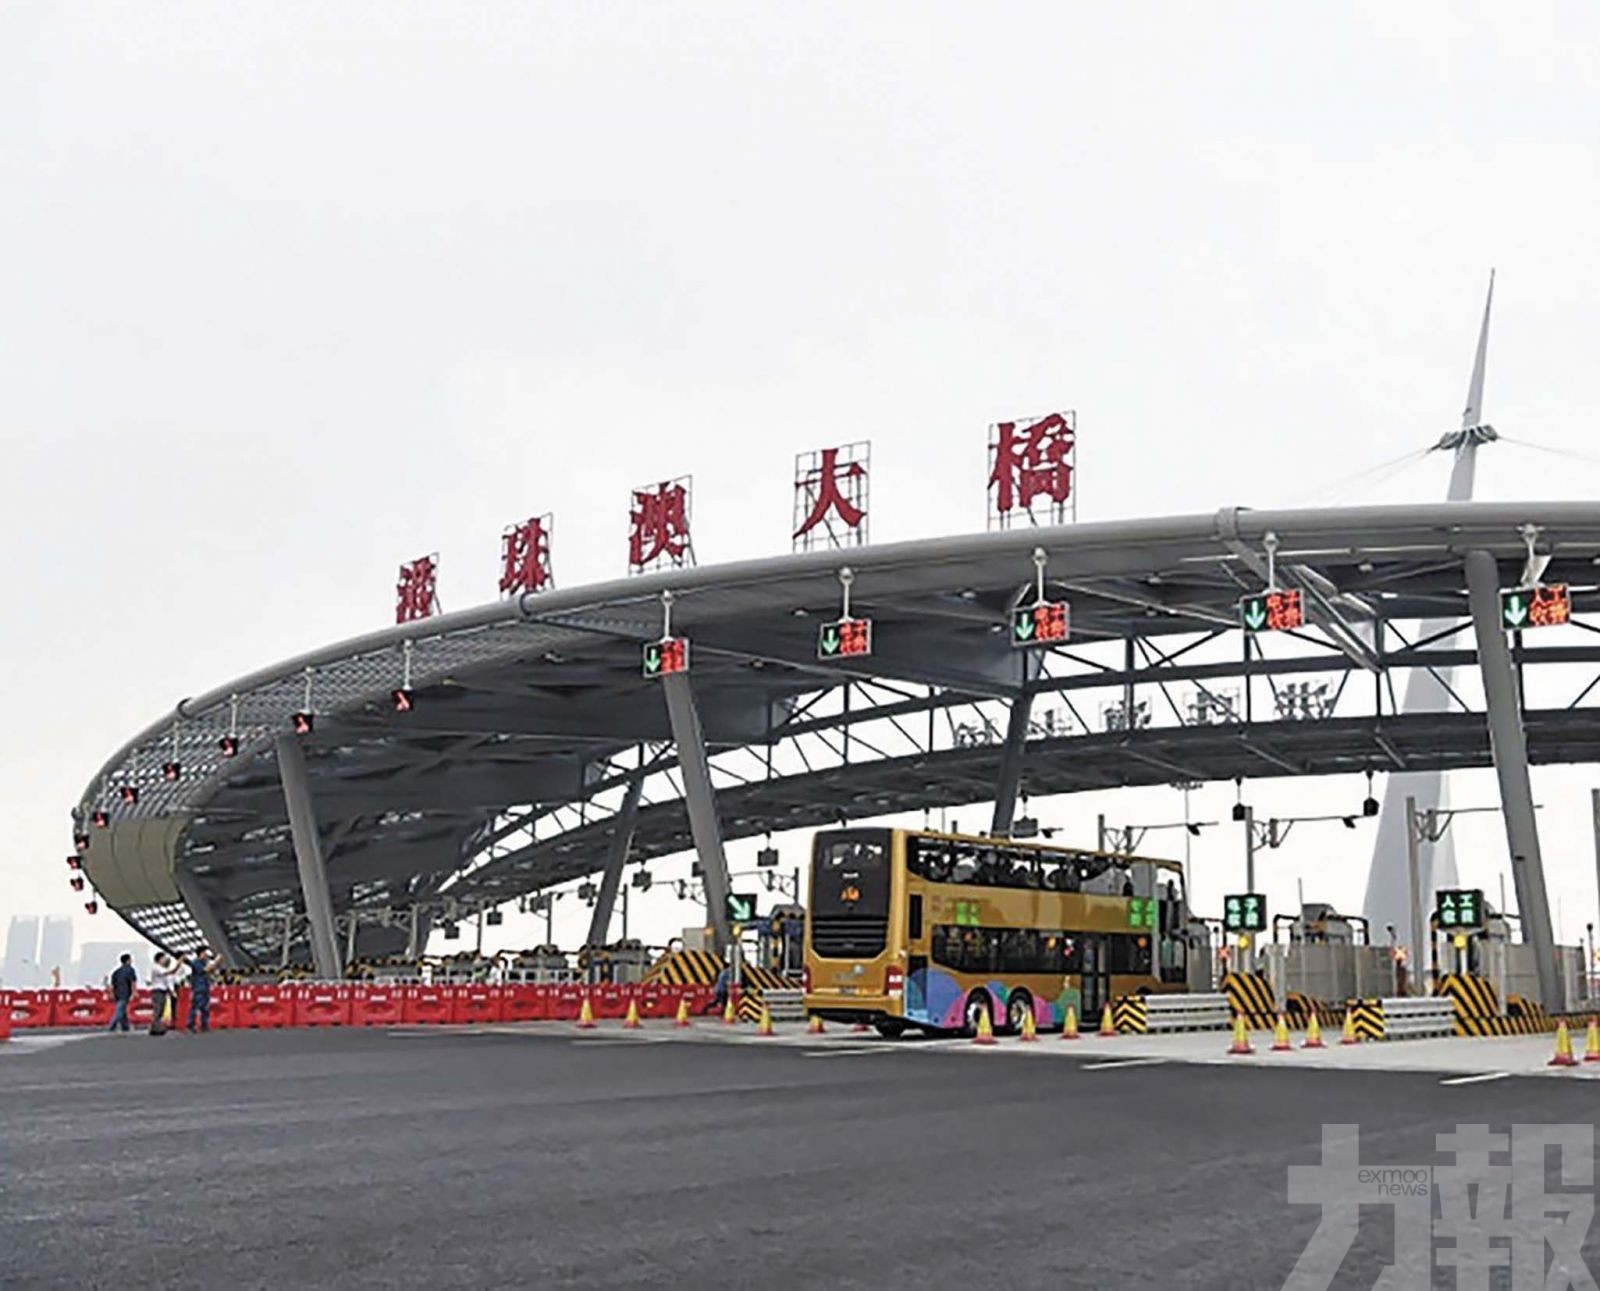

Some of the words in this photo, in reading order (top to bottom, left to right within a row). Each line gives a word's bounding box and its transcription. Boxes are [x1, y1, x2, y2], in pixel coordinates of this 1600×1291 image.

[396, 413, 1073, 624] 港珠澳大橋
[1441, 894, 1473, 908] 人工
